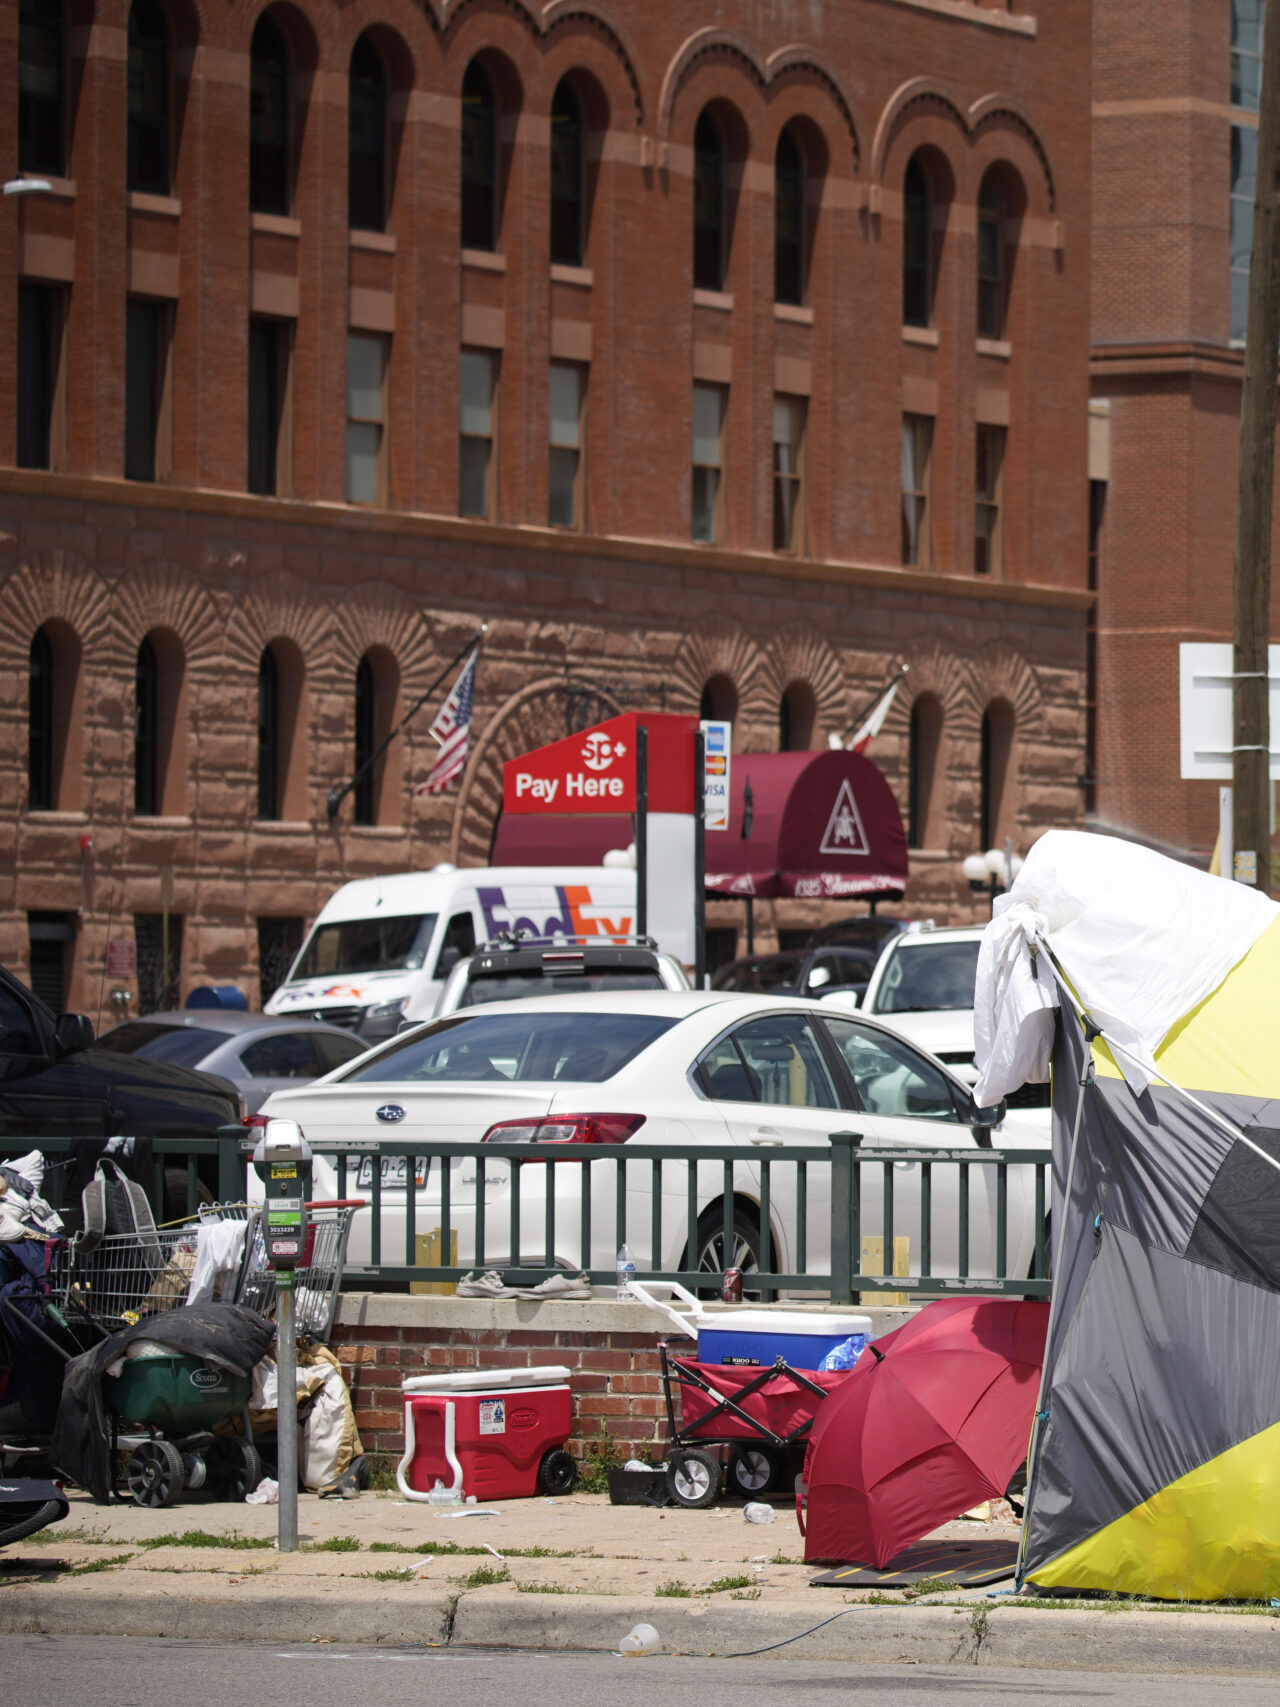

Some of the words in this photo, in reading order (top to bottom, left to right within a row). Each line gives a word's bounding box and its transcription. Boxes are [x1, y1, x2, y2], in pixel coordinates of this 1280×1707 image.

[516, 773, 559, 803] Pay
[566, 773, 624, 797] Here
[705, 784, 725, 796] VISA
